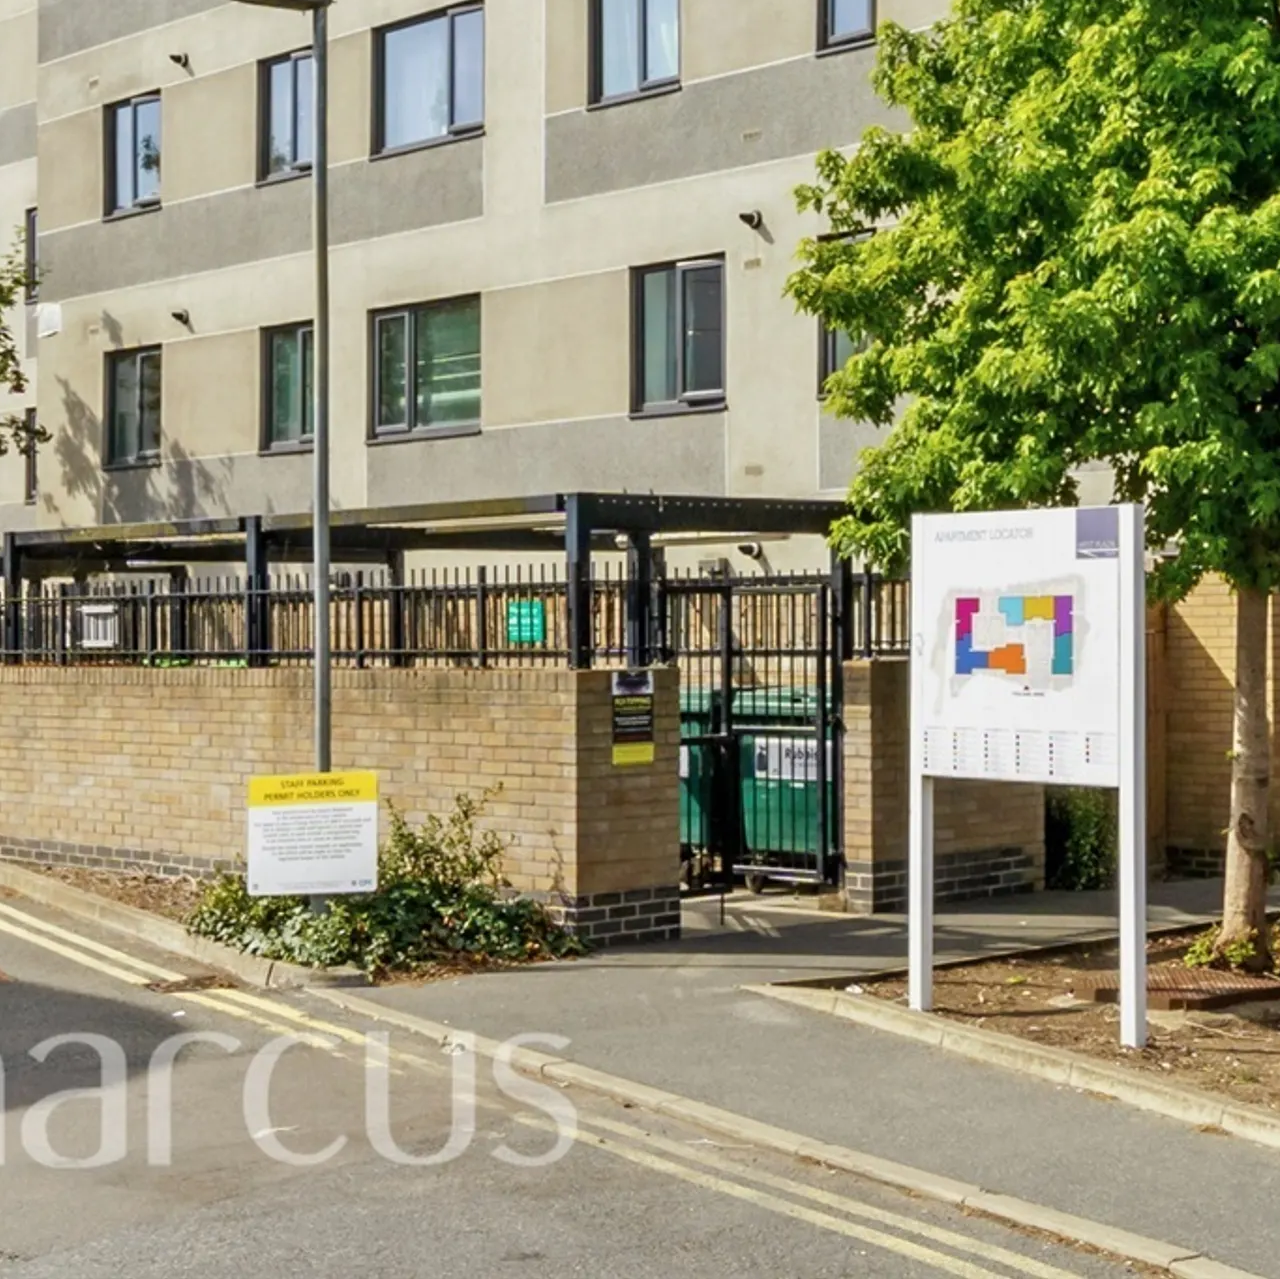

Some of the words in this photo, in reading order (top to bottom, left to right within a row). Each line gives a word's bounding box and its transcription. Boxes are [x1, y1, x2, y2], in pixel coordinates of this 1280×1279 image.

[280, 779, 304, 789] STAFF
[306, 777, 345, 787] PARKING
[263, 791, 294, 801] PERMIT
[296, 789, 336, 800] HOLDERS
[338, 788, 361, 798] ONLY
